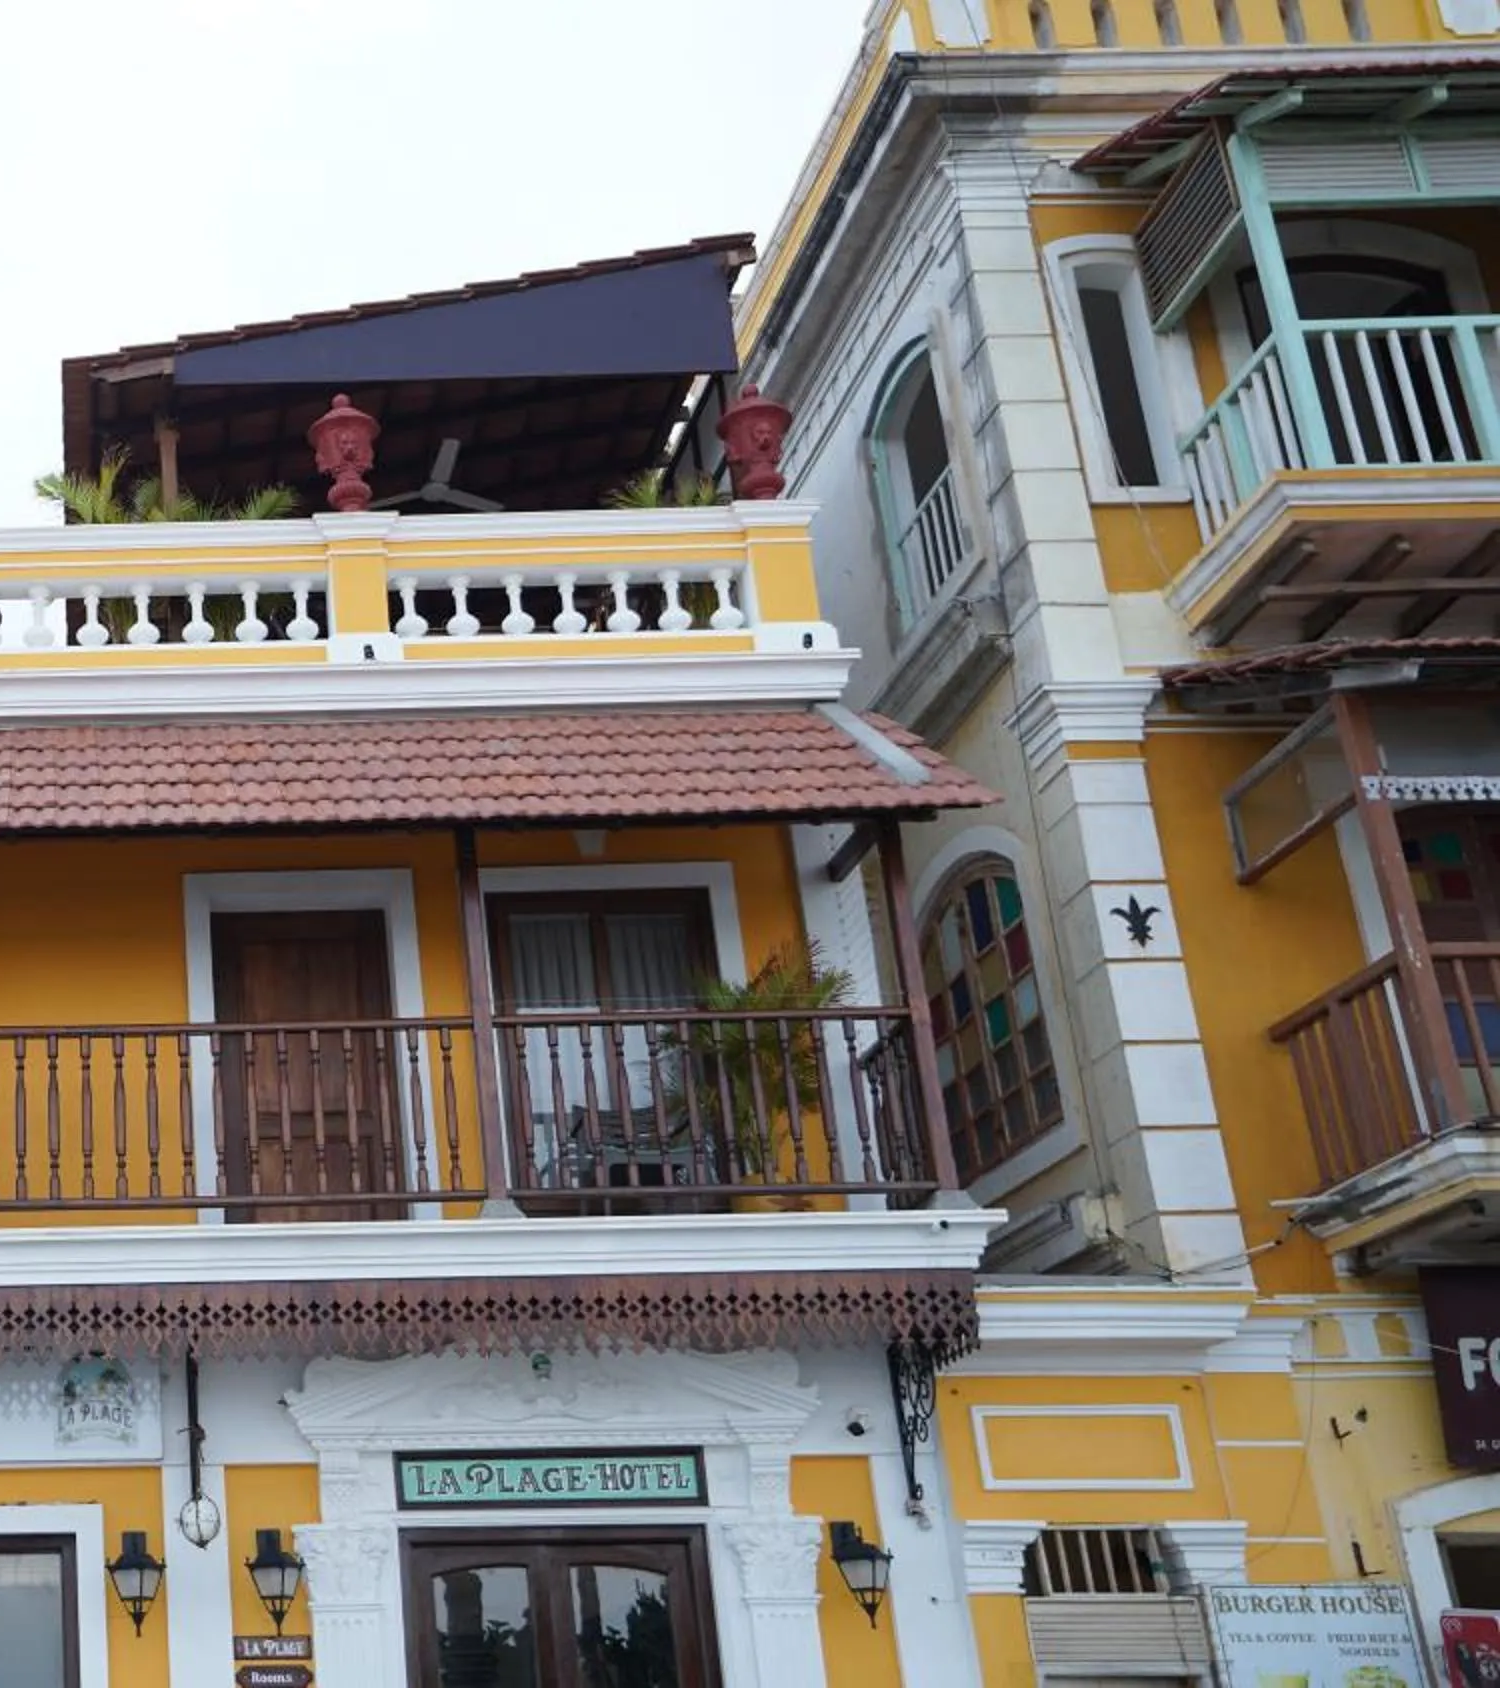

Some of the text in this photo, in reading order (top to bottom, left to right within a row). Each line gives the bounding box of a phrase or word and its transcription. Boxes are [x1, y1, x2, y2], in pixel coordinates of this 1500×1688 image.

[408, 1465, 462, 1496] LA
[1216, 1594, 1405, 1614] BURGER HOUSE
